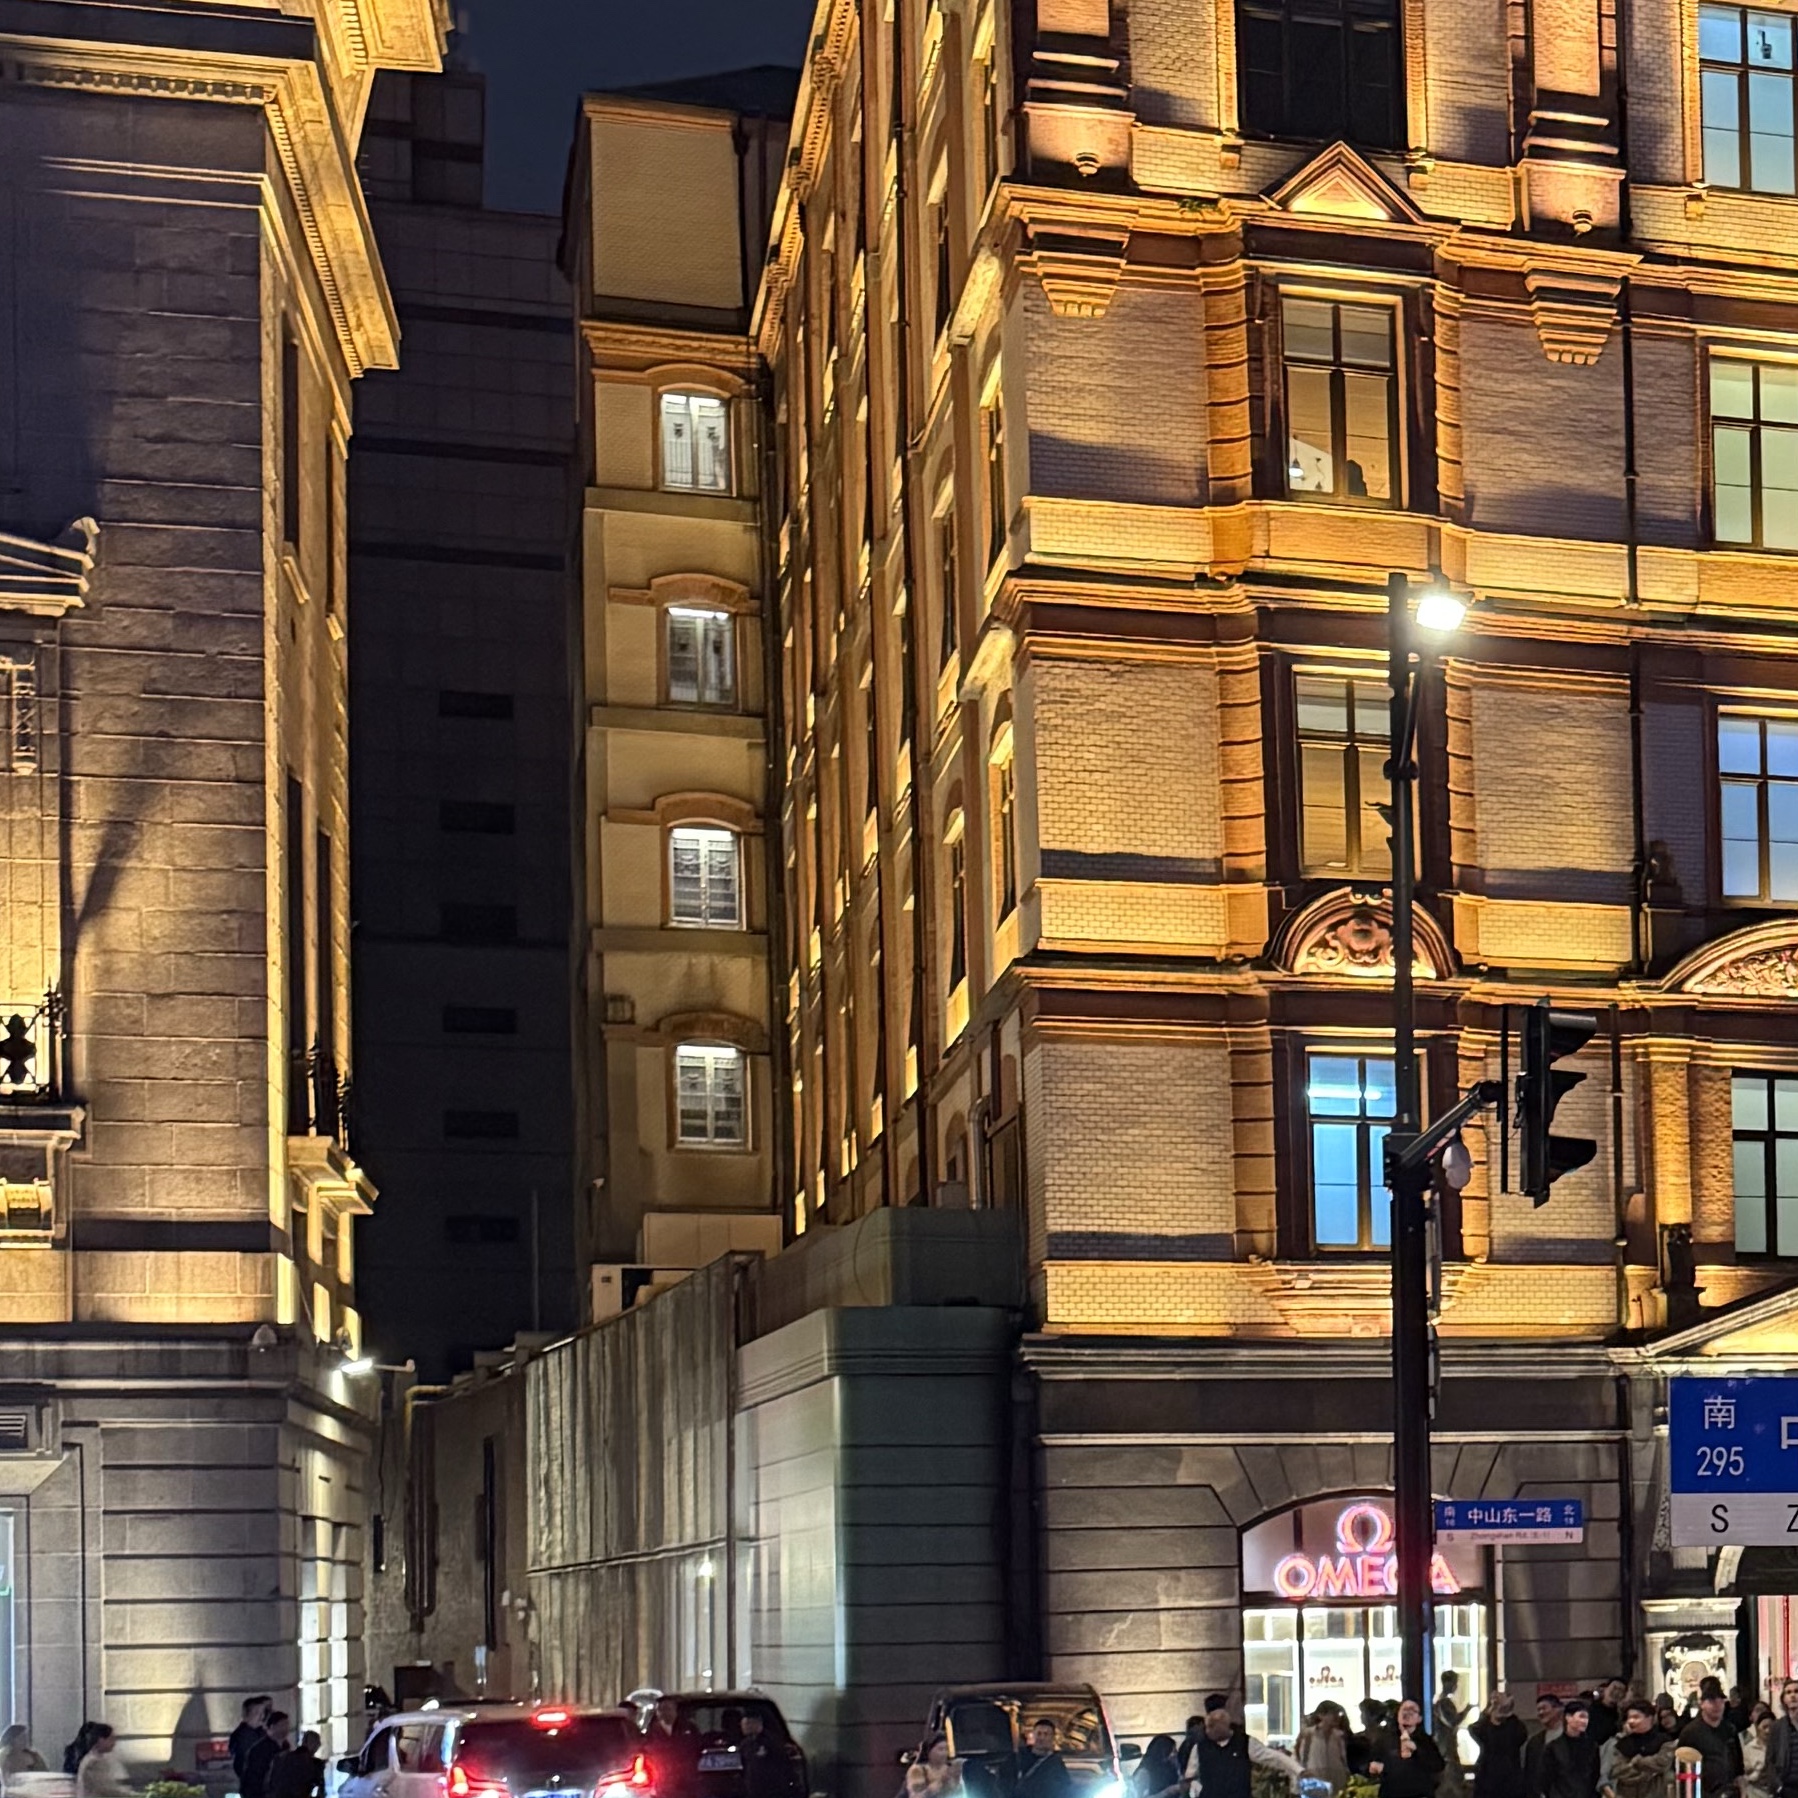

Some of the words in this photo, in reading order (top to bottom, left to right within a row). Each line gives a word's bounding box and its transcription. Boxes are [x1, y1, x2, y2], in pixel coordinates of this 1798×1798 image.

[1703, 1396, 1736, 1430] 南
[1696, 1446, 1745, 1477] 295
[1444, 1505, 1456, 1517] 南
[1467, 1506, 1552, 1525] 中山东一路
[1563, 1504, 1575, 1515] 北
[1710, 1504, 1730, 1533] S
[1565, 1531, 1573, 1539] N
